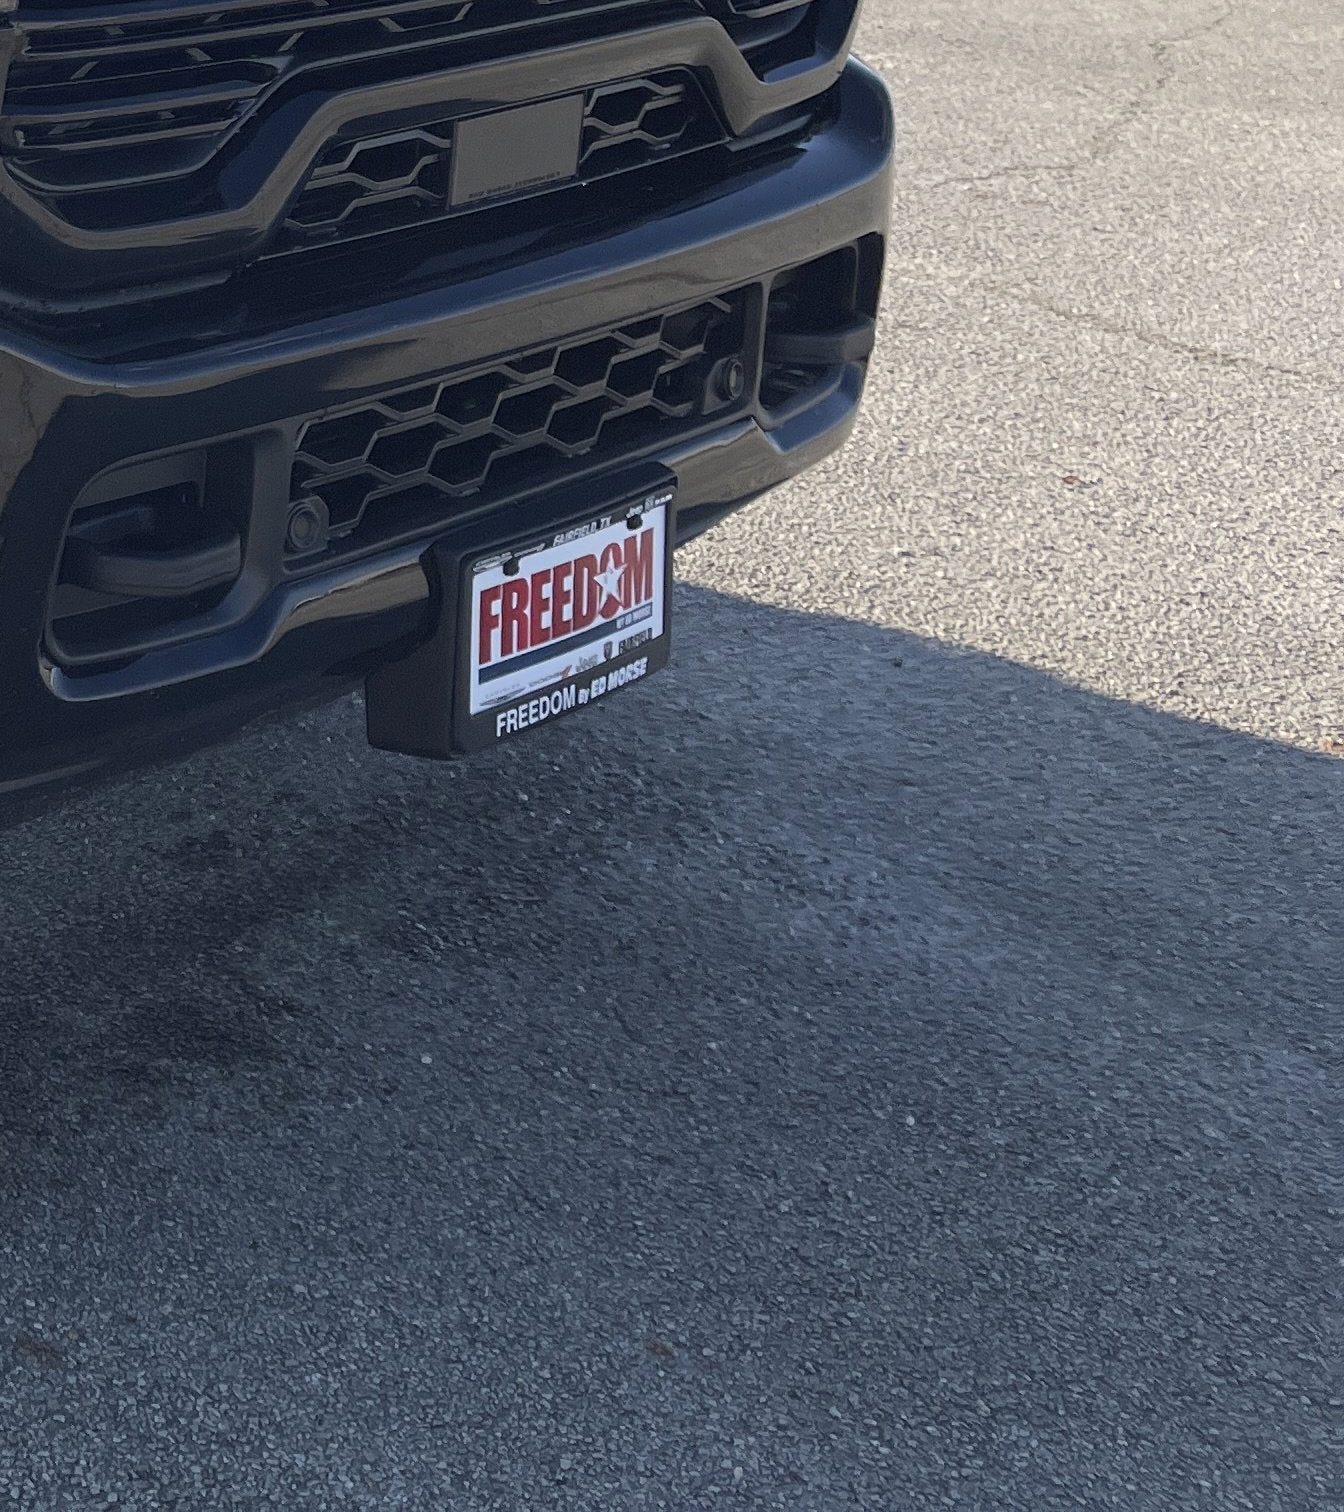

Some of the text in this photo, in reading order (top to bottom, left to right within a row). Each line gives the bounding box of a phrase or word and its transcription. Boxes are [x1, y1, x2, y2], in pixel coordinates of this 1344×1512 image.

[479, 526, 653, 666] FREEDOM
[496, 683, 576, 738] FREEDOM
[591, 675, 607, 699] ED
[607, 656, 649, 697] MORSE
